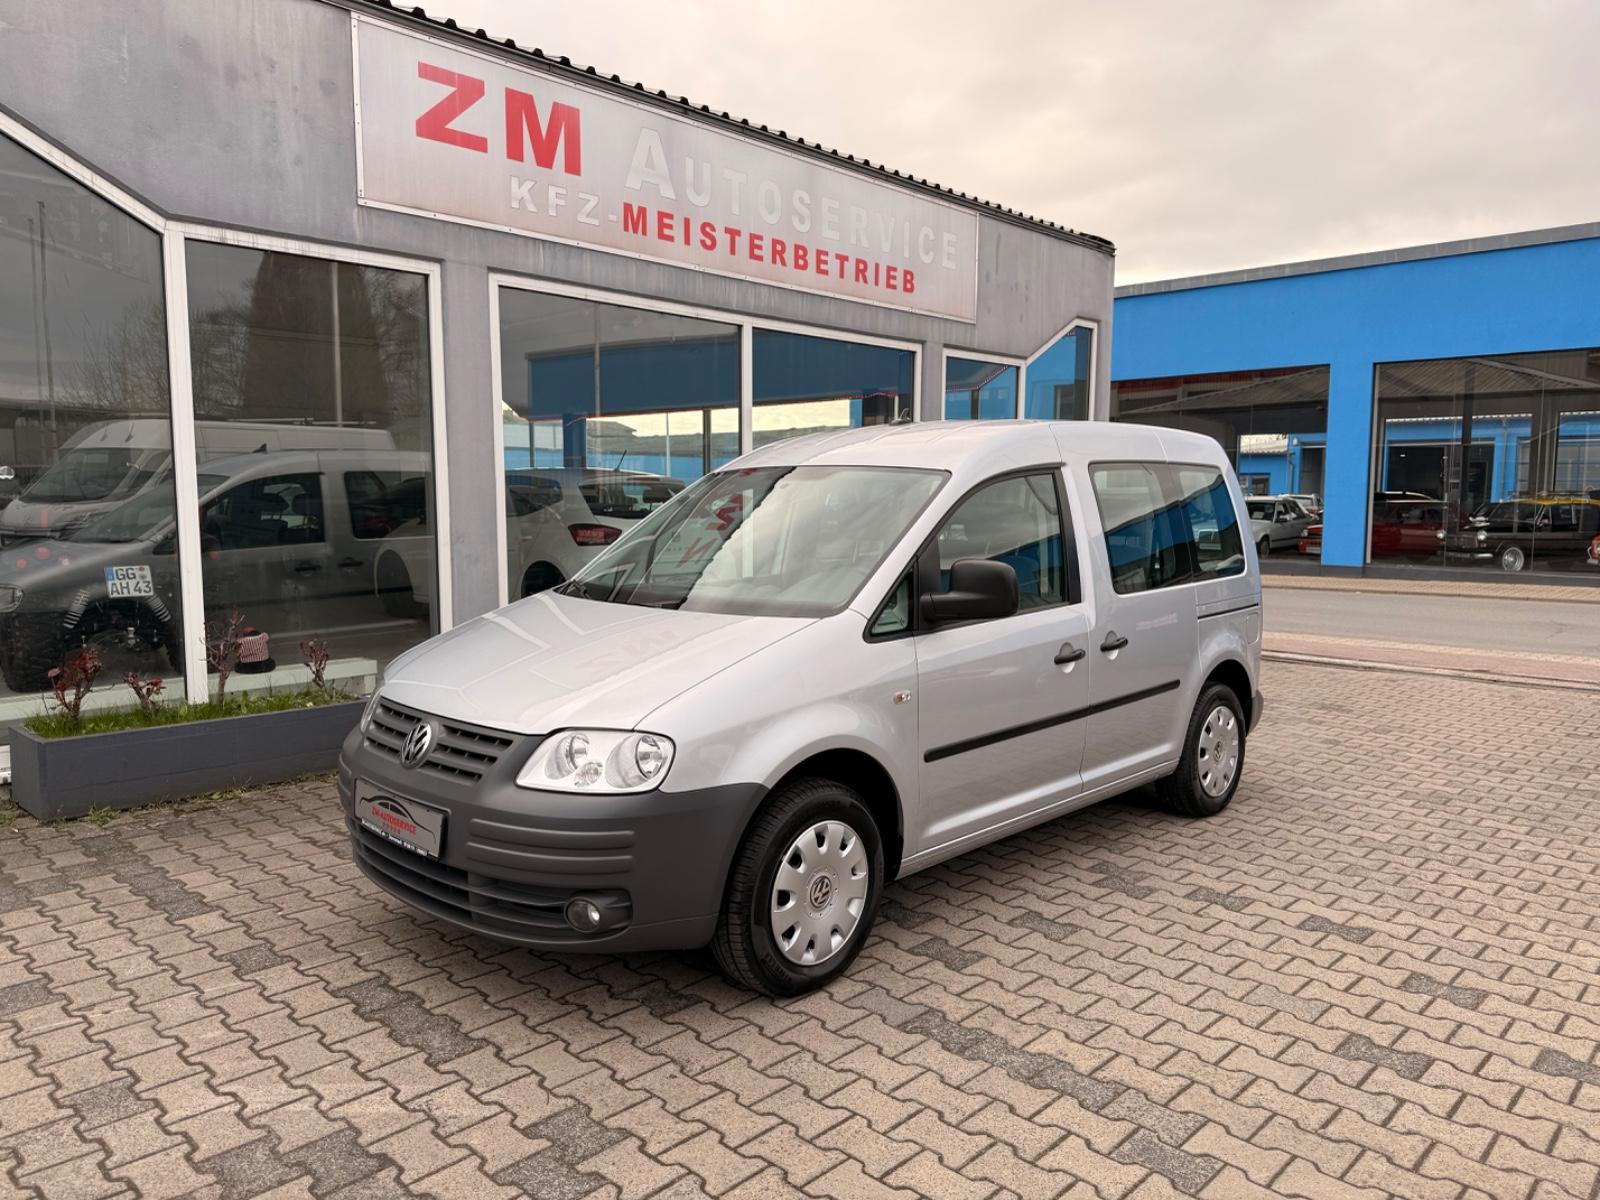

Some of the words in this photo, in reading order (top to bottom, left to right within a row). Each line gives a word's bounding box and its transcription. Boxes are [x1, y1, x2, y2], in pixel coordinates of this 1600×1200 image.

[415, 60, 582, 177] ZM
[624, 127, 958, 271] AUTOSERVICE
[510, 175, 915, 294] KFZ-MEISTERBETRIEB
[110, 581, 131, 595] AH
[133, 581, 152, 594] 43
[115, 567, 137, 581] GG
